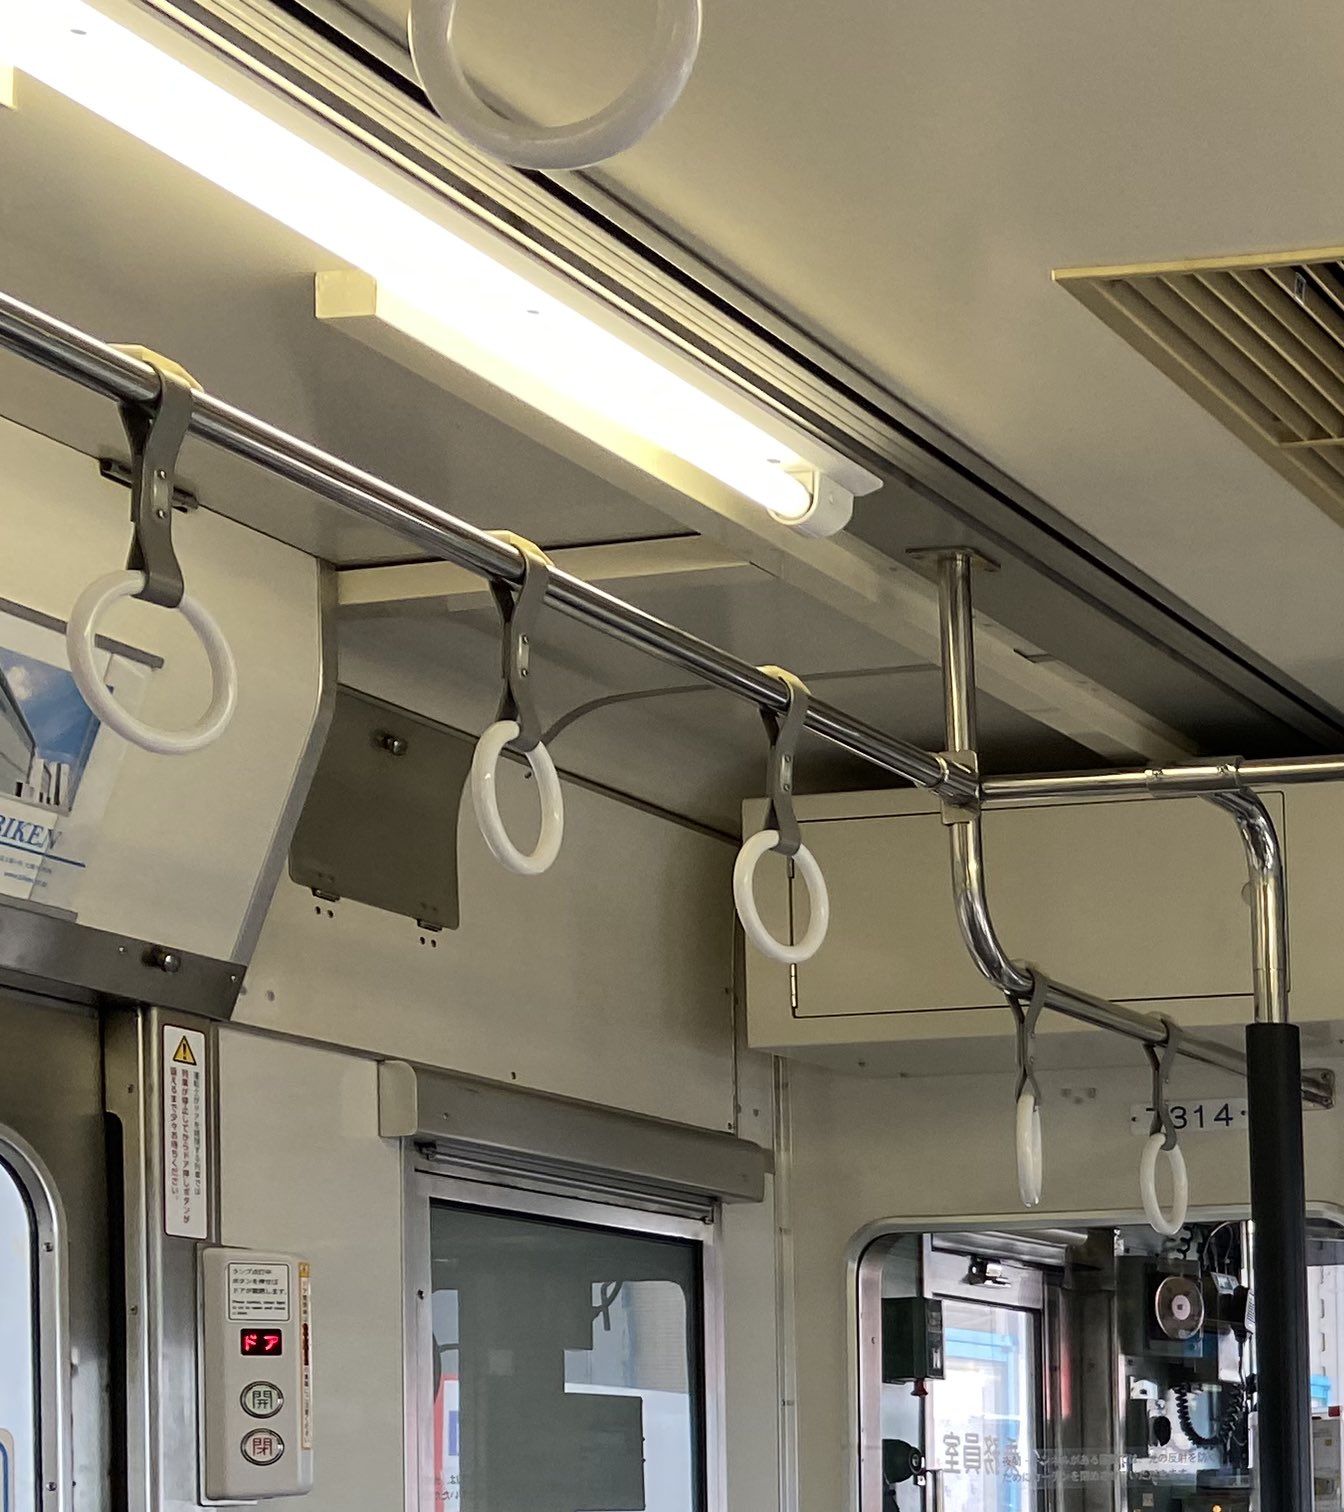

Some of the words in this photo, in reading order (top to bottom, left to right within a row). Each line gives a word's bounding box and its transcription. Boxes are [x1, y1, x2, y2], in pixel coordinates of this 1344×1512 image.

[1145, 1103, 1233, 1130] 314
[244, 1334, 279, 1351] ドア
[252, 1390, 273, 1409] 開
[252, 1437, 273, 1456] 閉
